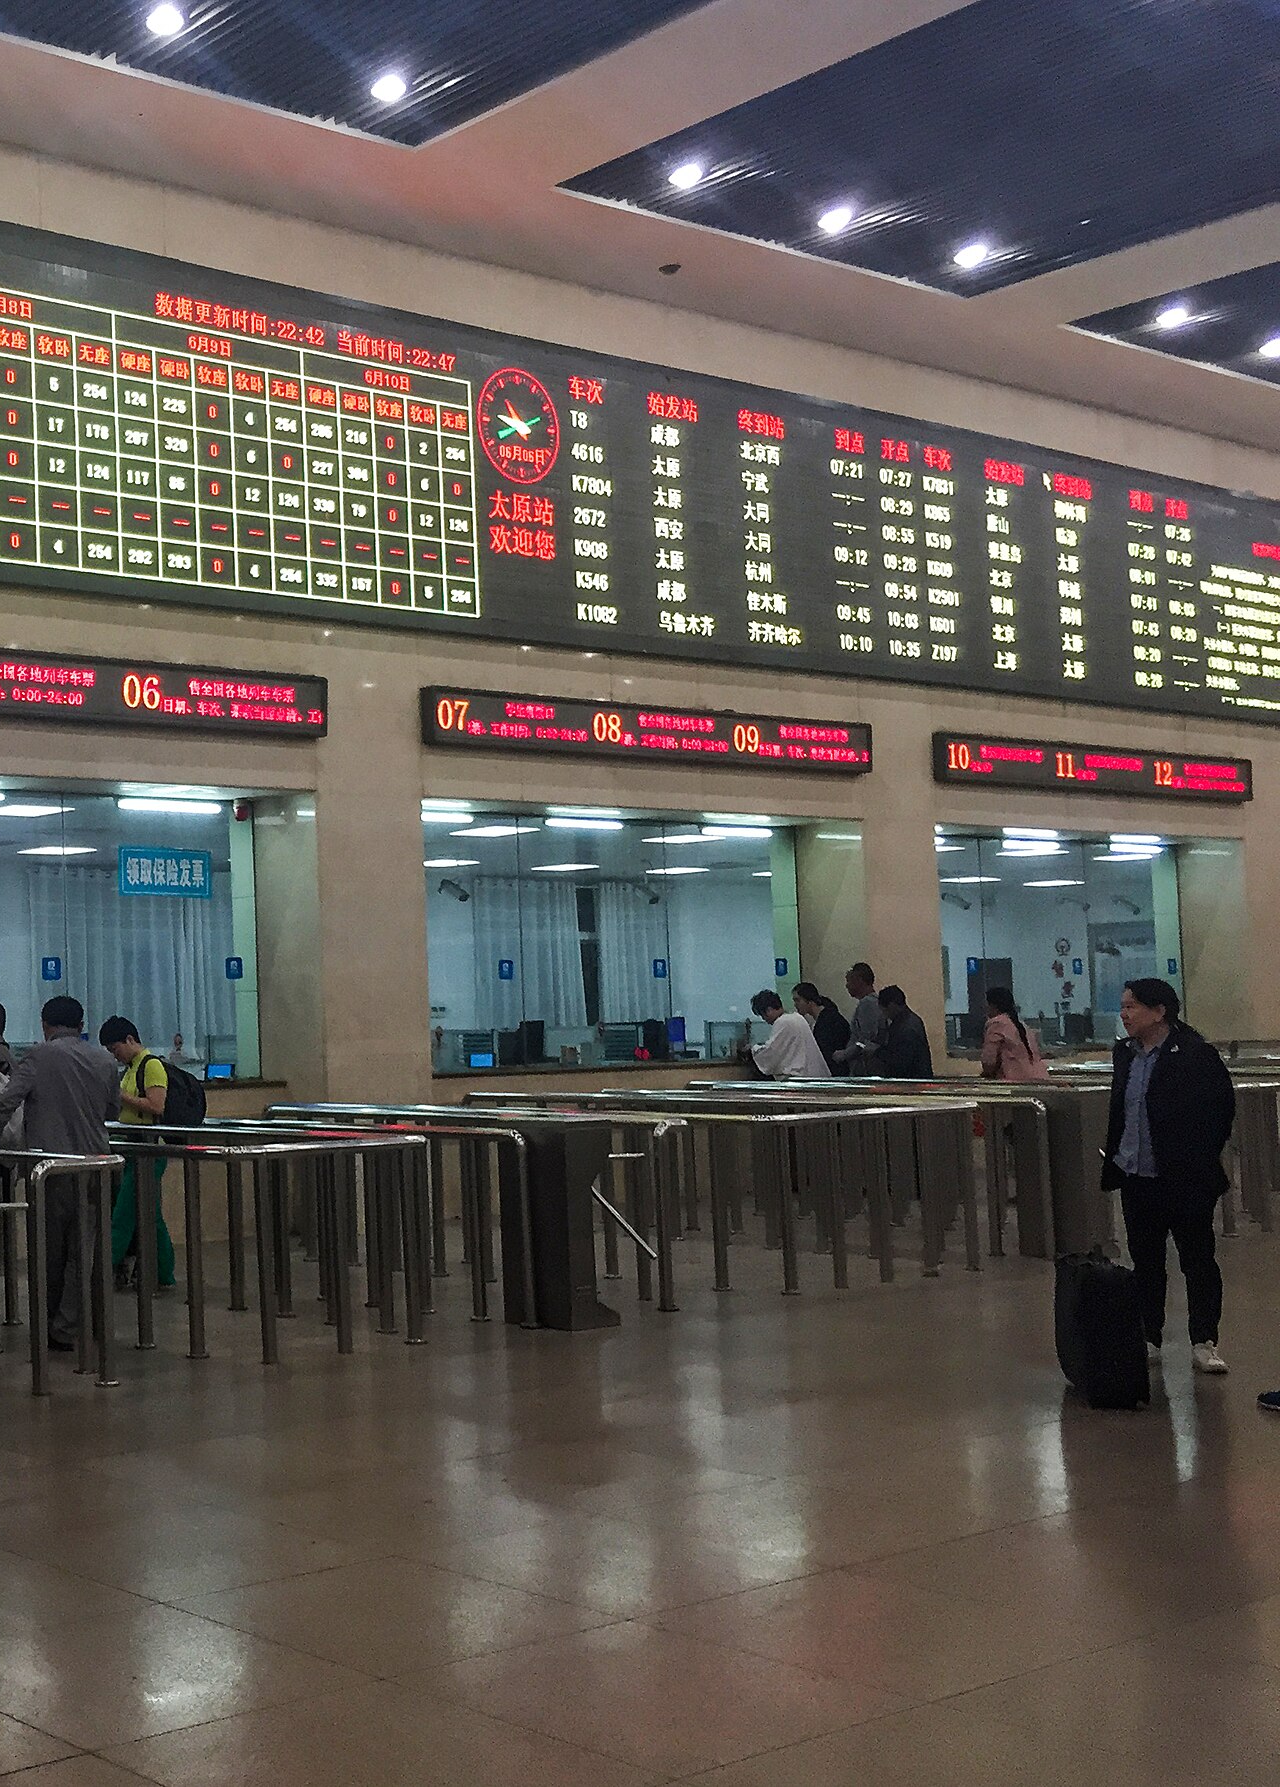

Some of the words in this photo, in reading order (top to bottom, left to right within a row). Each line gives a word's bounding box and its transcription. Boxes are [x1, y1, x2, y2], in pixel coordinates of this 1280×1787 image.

[155, 292, 324, 346] 数据更新时间:22:42
[188, 334, 232, 357] 6月9日
[337, 330, 456, 372] 当前时间:22:47
[36, 334, 71, 357] 软卧
[78, 342, 111, 365] 无座
[119, 350, 151, 372] 硬座
[159, 358, 189, 379] 硬卧
[196, 364, 227, 386] 软座
[234, 372, 263, 393] 软卧
[271, 379, 299, 399] 无座
[306, 386, 335, 406] 硬座
[342, 392, 369, 412] 硬卧
[375, 397, 402, 418] 软座
[409, 404, 435, 424] 软卧
[442, 410, 467, 430] 无座
[365, 369, 411, 392] 6月10日
[568, 376, 603, 404] 车次
[647, 392, 698, 422] 始发站
[738, 409, 784, 439] 终到站
[835, 428, 864, 453] 到点
[881, 439, 909, 462] 开点
[924, 446, 951, 471] 车次
[570, 410, 587, 429] T8
[651, 424, 679, 447] 成都
[740, 441, 780, 465] 北京西
[830, 459, 862, 478] 07:21
[880, 468, 912, 487] 07:27
[571, 443, 603, 463] 4616
[652, 455, 680, 478] 太原
[742, 470, 769, 493] 宁武
[881, 497, 913, 515] 08:29
[488, 489, 555, 527] 太原站
[572, 475, 612, 496] K7804
[654, 486, 681, 509] 太原
[743, 501, 769, 523] 大同
[882, 525, 914, 544] 08:55
[489, 525, 557, 561] 欢迎您
[574, 507, 605, 527] 2672
[654, 518, 683, 539] 西安
[745, 531, 770, 553] 大同
[835, 546, 867, 565] 09:12
[884, 554, 916, 572] 09:28
[990, 569, 1012, 588] 北京
[575, 539, 607, 559] K908
[656, 548, 684, 571] 太原
[745, 560, 771, 583] 杭州
[885, 582, 917, 600] 09:54
[576, 571, 608, 591] K546
[657, 580, 686, 602] 成都
[747, 591, 786, 614] 佳木斯
[837, 605, 870, 623] 09:45
[888, 611, 918, 629] 10:03
[992, 624, 1015, 643] 北京
[578, 603, 617, 623] K1082
[659, 611, 714, 636] 乌鲁木齐
[748, 621, 801, 645] 齐齐哈尔
[840, 634, 872, 652] 10:10
[889, 640, 920, 657] 10:35
[932, 645, 957, 661] Z197
[994, 651, 1016, 670] 上海
[124, 675, 160, 709] 06
[438, 700, 470, 730] 07
[593, 712, 622, 743] 08
[733, 724, 760, 752] 09
[949, 744, 969, 769] 10
[1056, 752, 1075, 777] 11
[1154, 762, 1172, 785] 12
[126, 856, 204, 887] 领取保险发票
